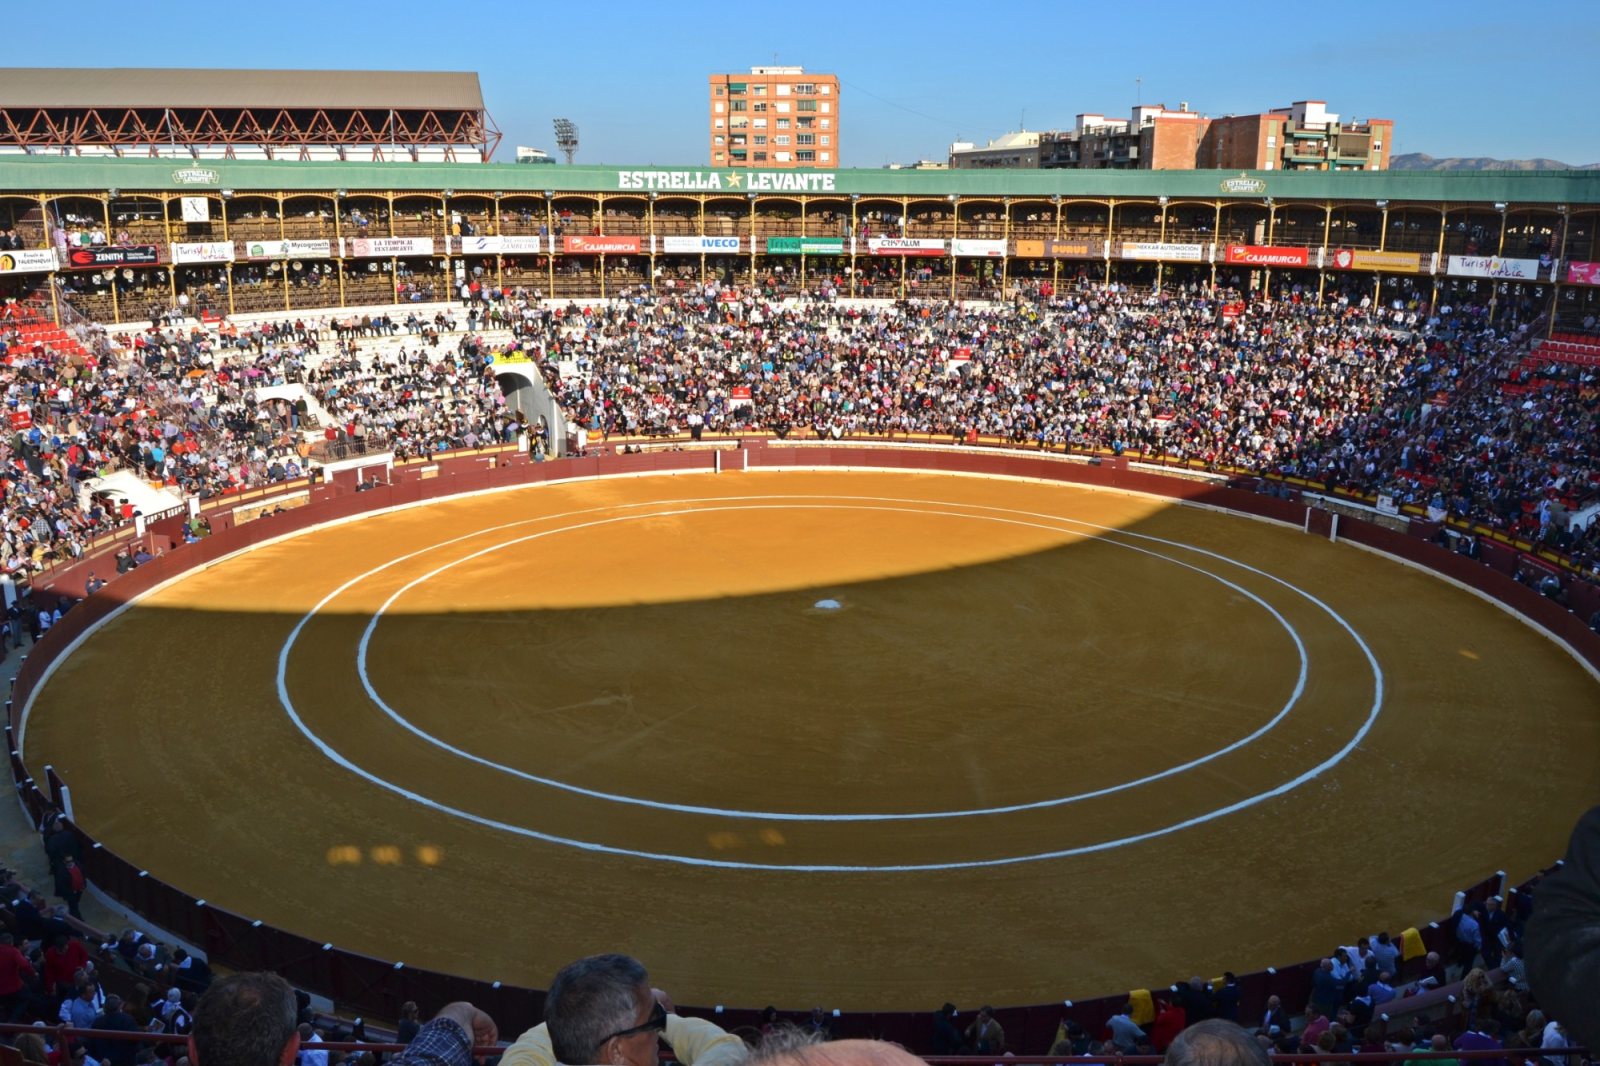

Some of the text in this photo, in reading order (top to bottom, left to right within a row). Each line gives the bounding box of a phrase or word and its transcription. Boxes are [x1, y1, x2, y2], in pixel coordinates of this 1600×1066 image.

[178, 170, 213, 178] ESTRELLA
[618, 171, 835, 190] ESTRELLA LEVANTE
[584, 243, 636, 251] CAJAMURCIA
[702, 239, 738, 247] IVECO
[881, 239, 920, 247] CRISTALUM
[95, 252, 124, 262] ZENITH
[1246, 254, 1302, 264] CAJAMURCIA
